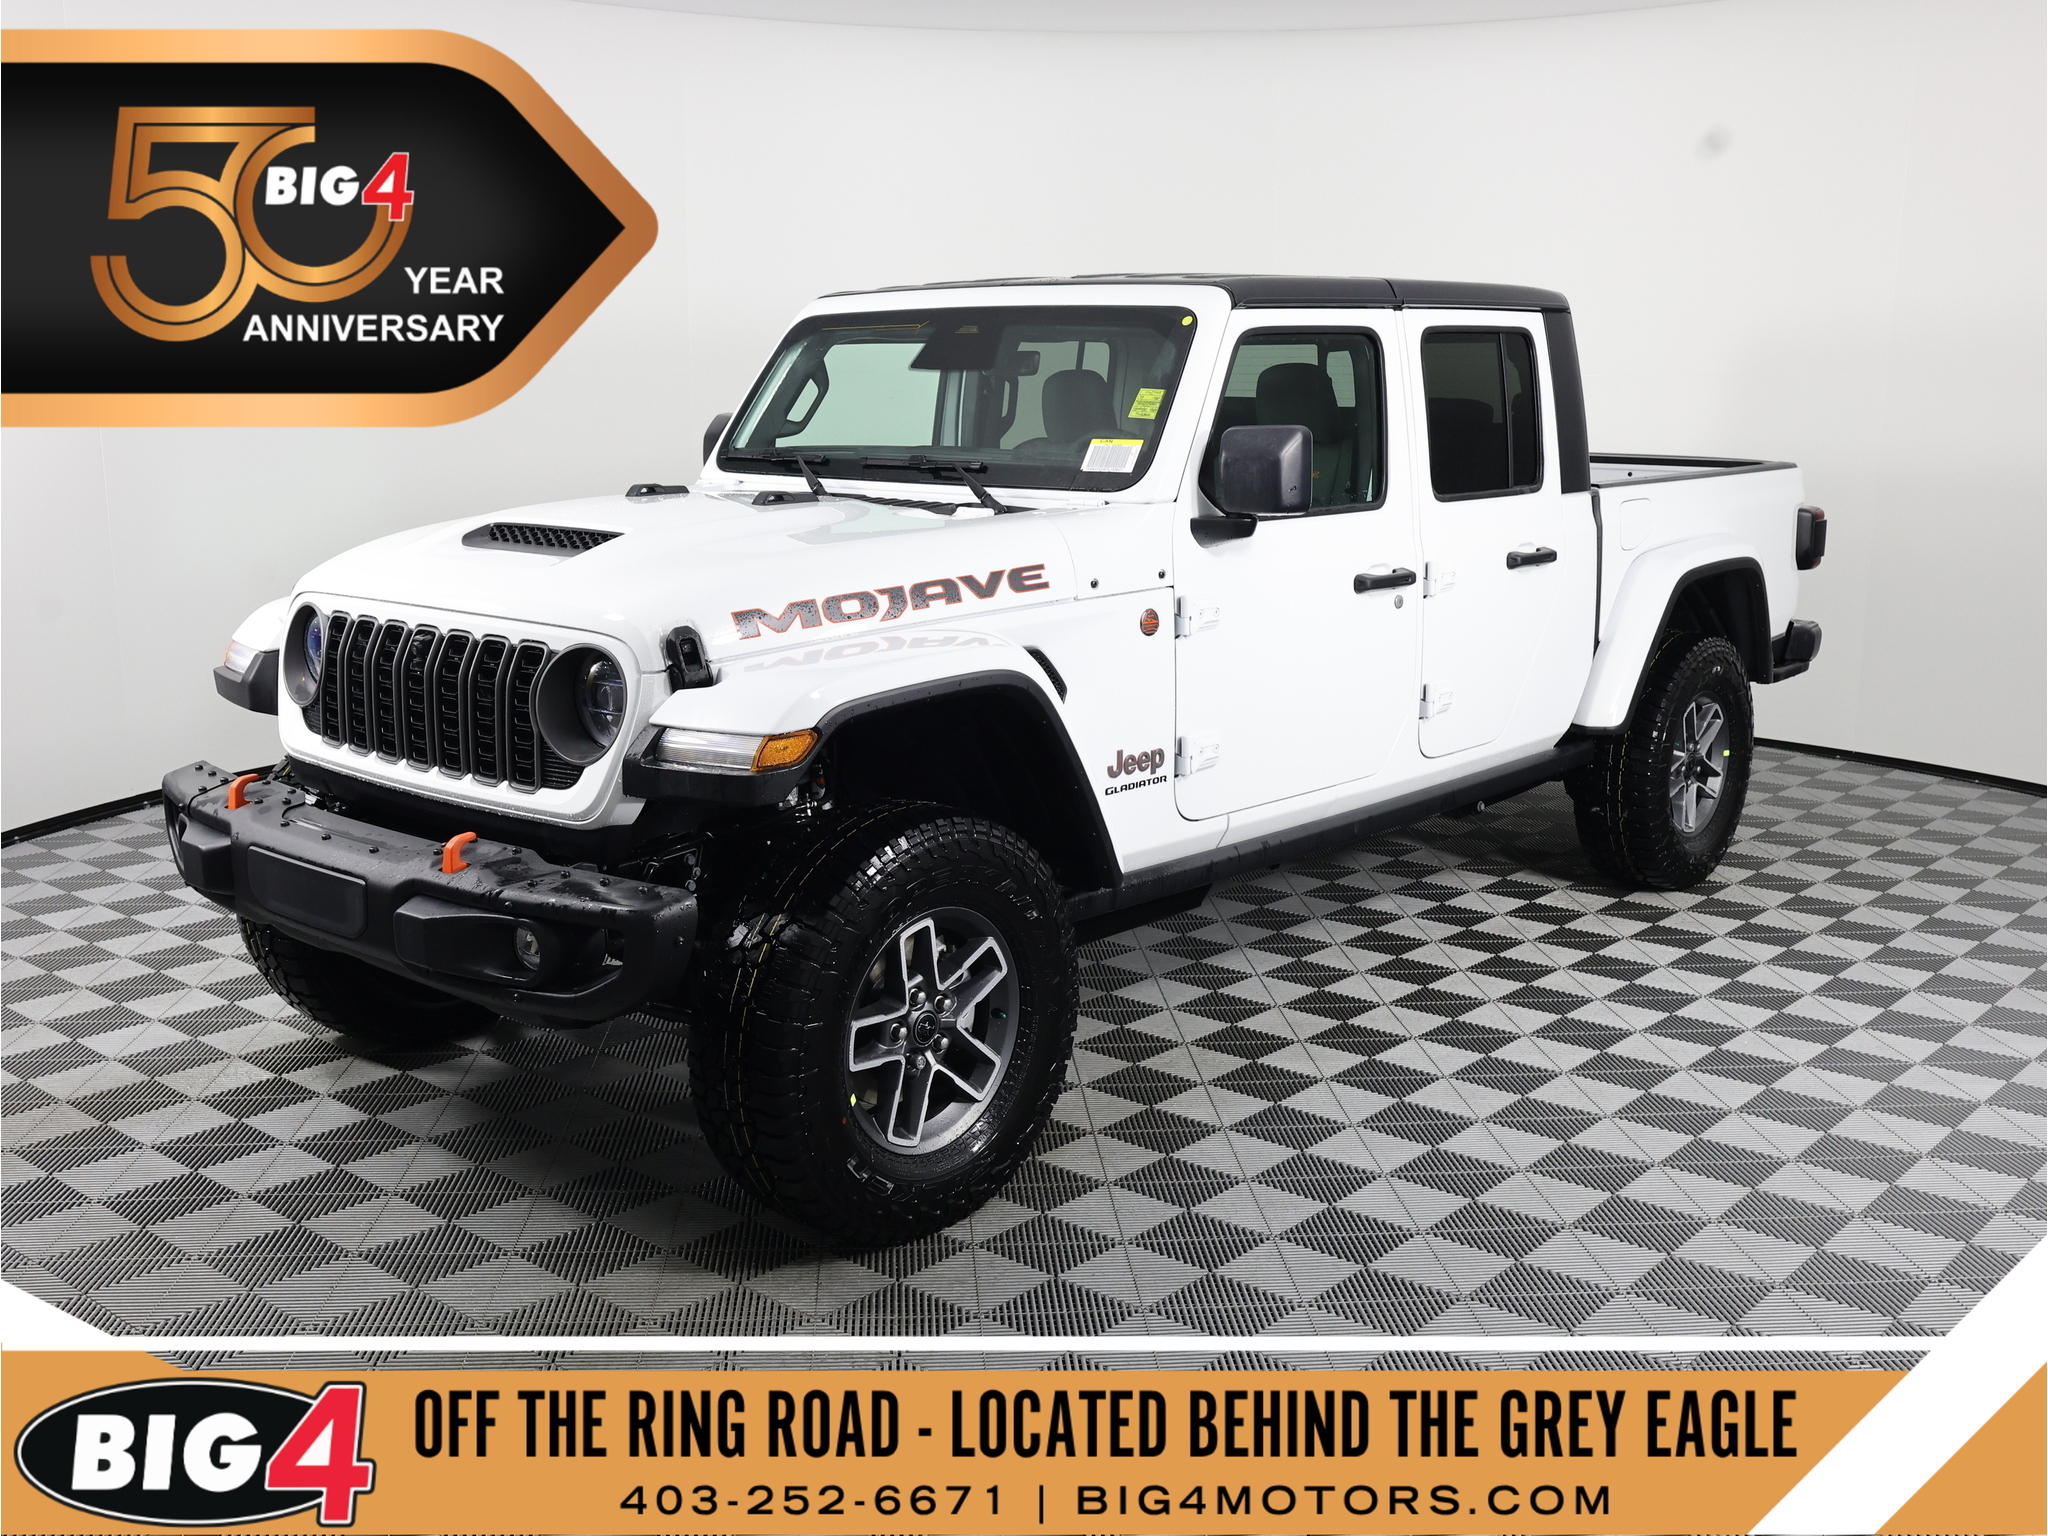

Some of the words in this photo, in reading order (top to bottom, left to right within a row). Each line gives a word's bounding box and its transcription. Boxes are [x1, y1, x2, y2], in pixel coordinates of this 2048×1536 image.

[731, 563, 1050, 640] MOJAVE
[1107, 747, 1165, 779] Jeep
[1104, 775, 1168, 796] GLADIATOR
